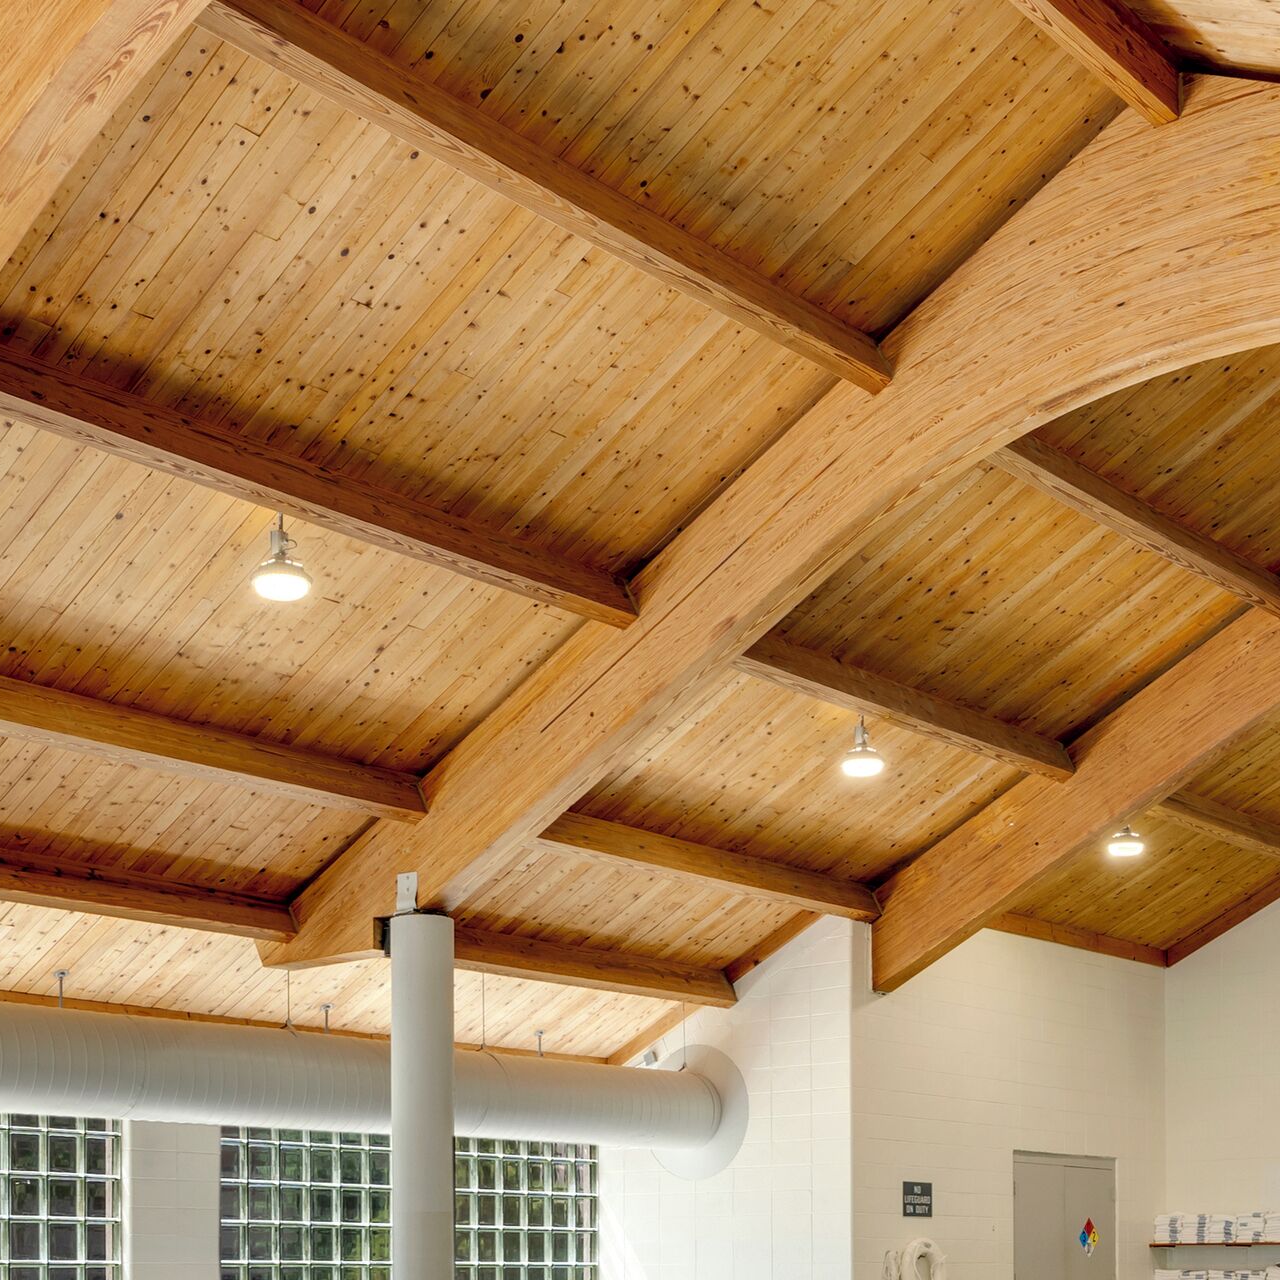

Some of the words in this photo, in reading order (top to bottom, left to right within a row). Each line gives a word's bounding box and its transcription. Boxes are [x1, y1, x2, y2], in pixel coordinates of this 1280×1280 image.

[913, 1185, 922, 1194] NO
[904, 1195, 931, 1204] LIFEGUARD
[905, 1204, 914, 1213] ON
[915, 1204, 929, 1214] DUTY
